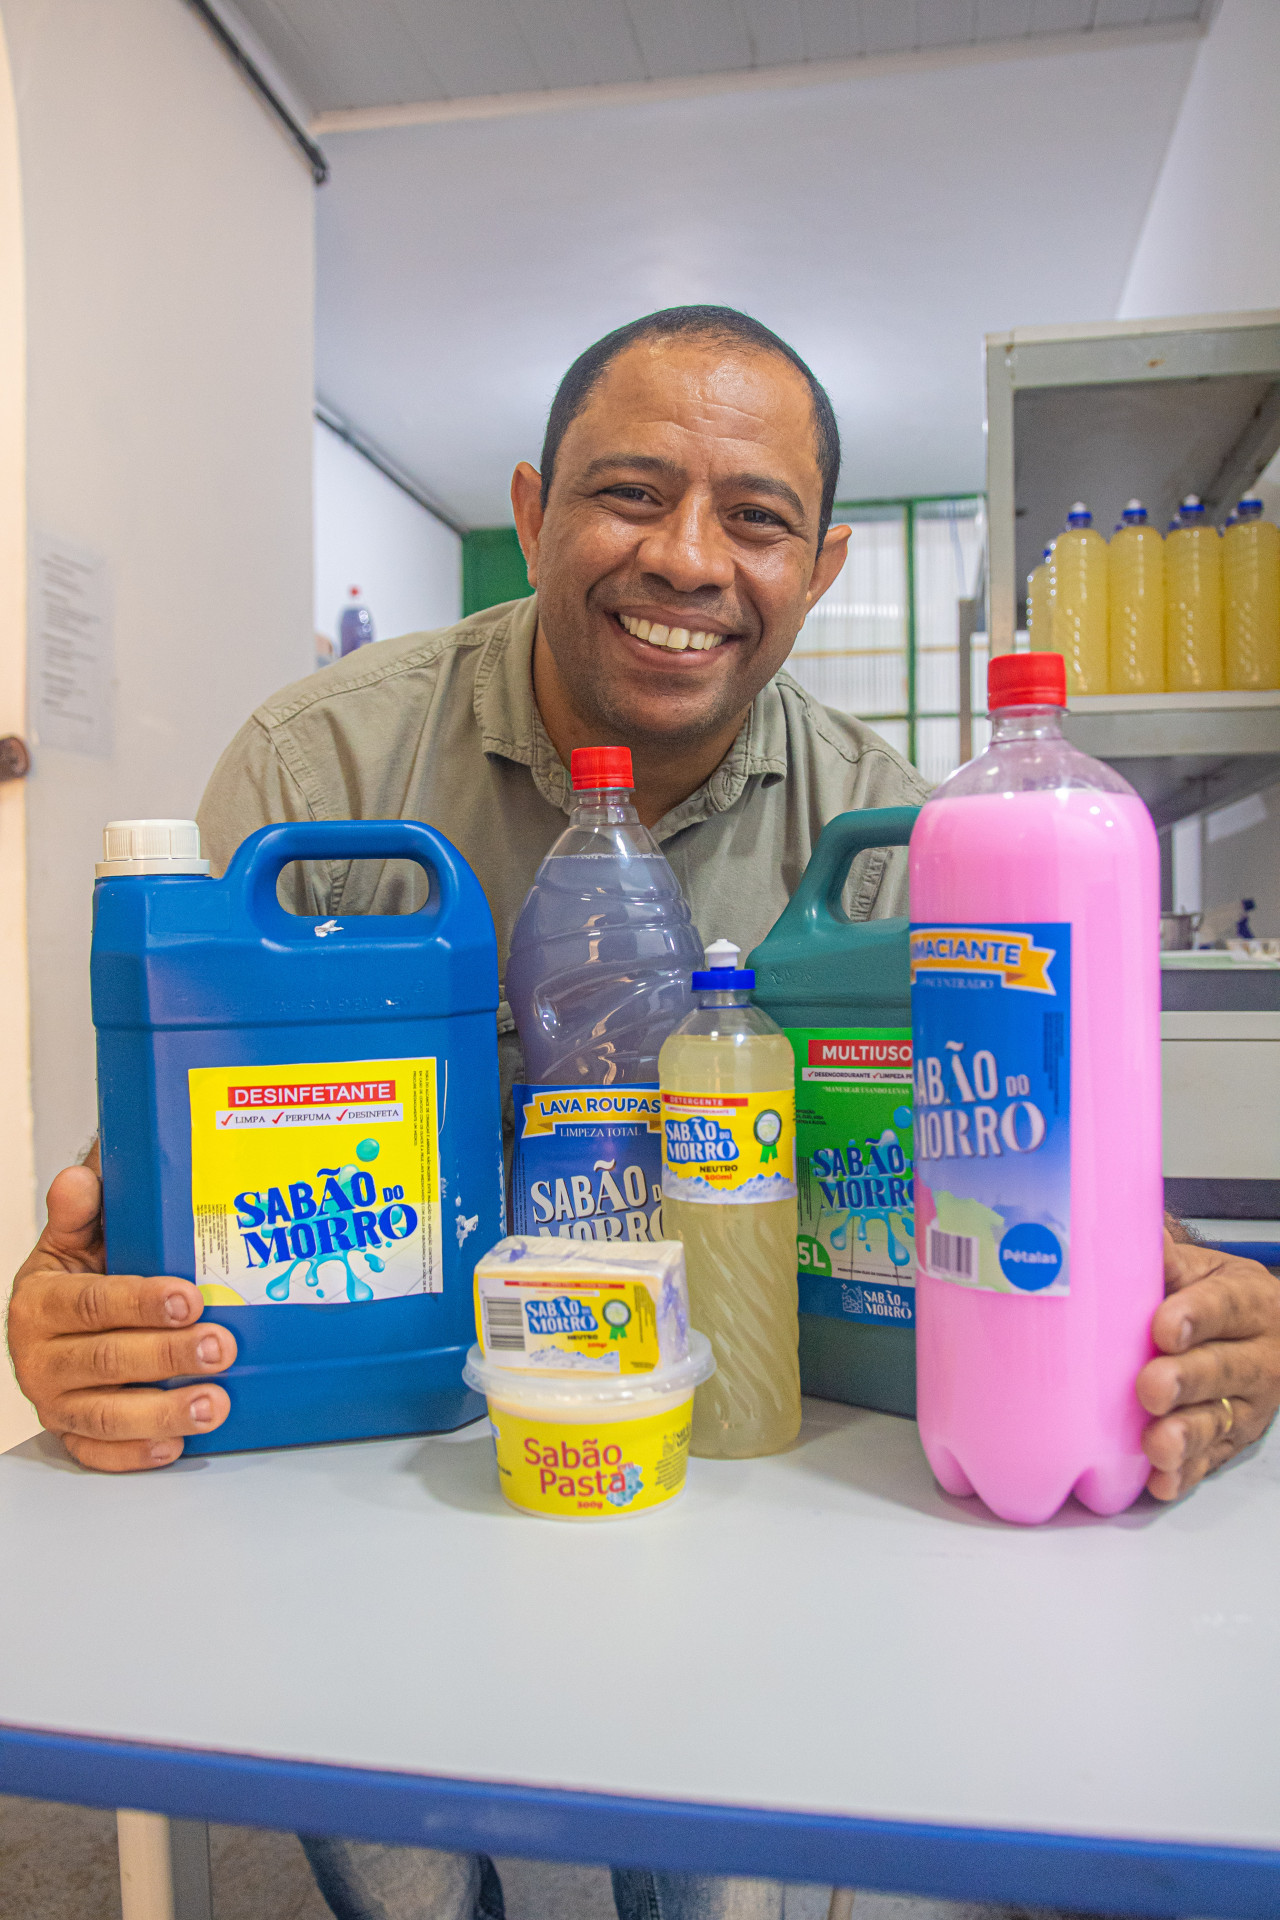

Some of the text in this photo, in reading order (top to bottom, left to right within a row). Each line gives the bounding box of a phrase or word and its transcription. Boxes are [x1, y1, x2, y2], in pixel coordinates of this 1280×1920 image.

[822, 1045, 912, 1062] MULTIUSO
[814, 1071, 871, 1079] DESENGORDURANTE
[914, 1040, 998, 1107] ABÃO
[1005, 1074, 1030, 1097] DO
[234, 1083, 391, 1105] DESINFETANTE
[669, 1095, 724, 1107] DETERGENTE
[235, 1109, 399, 1124] LIMPA PERFUMA DESINFETA
[540, 1098, 582, 1116] LAVA
[586, 1097, 661, 1114] ROUPAS
[560, 1126, 642, 1138] LIMPEZA TOTAL
[665, 1117, 717, 1142] SABÃO
[668, 1140, 737, 1161] MORRO
[813, 1137, 905, 1177] SABÃO
[699, 1164, 738, 1173] NEUTRO
[233, 1167, 404, 1229] SABÃO DO
[530, 1158, 648, 1224] SABÃO
[652, 1183, 661, 1203] D
[240, 1203, 418, 1269] MORRO
[798, 1241, 827, 1269] 5L
[1003, 1247, 1057, 1265] Pétalas
[526, 1297, 579, 1318] SABÃO
[863, 1290, 901, 1306] SABÃO
[864, 1303, 913, 1319] MORRO
[530, 1316, 595, 1332] MORRO
[523, 1438, 622, 1469] Sabão
[539, 1468, 627, 1497] Pasta
